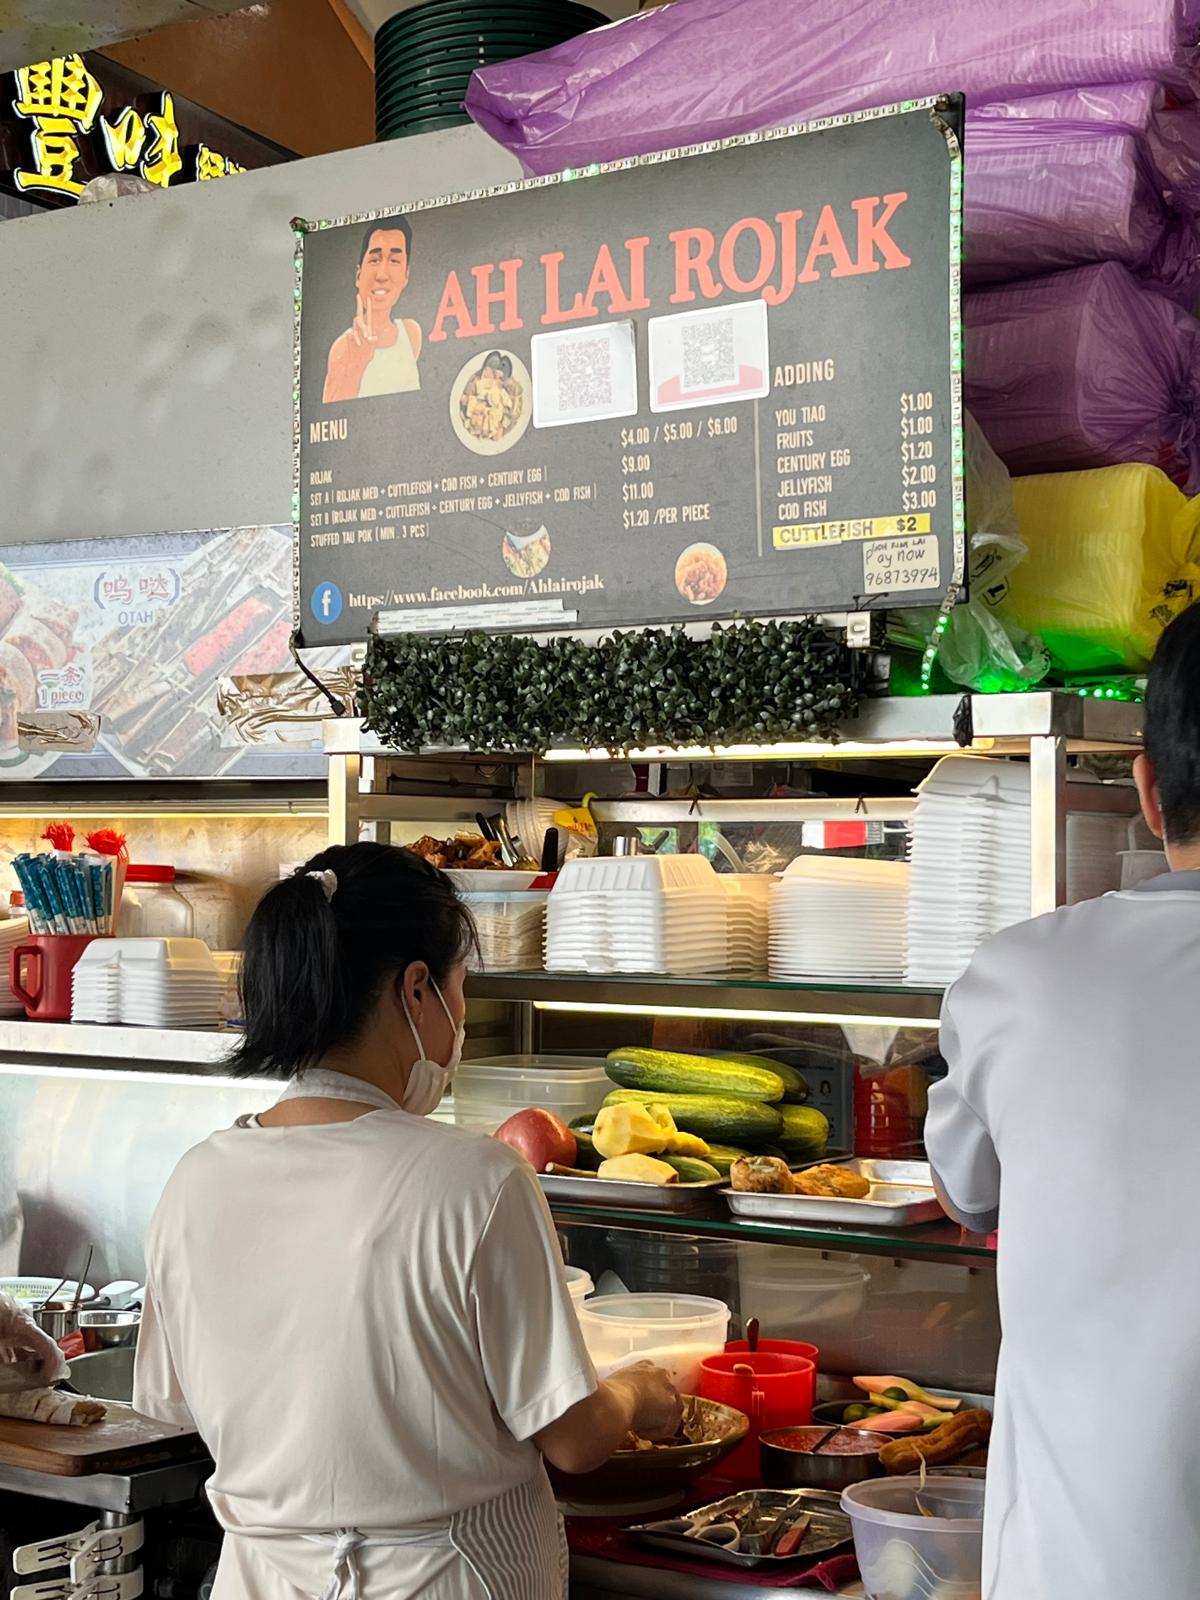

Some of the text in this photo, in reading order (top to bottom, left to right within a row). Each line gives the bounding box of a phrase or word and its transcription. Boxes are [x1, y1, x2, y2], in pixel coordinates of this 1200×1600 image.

[14, 53, 248, 200] 豐味
[428, 191, 912, 342] AH LAI ROJAK
[774, 358, 835, 387] ADDING
[900, 391, 933, 415] $1.00
[775, 404, 826, 427] YOU TIAO
[309, 418, 348, 444] MENU
[620, 426, 650, 449] $4.00
[663, 421, 693, 443] $5.00
[707, 415, 738, 438] $6.00
[900, 416, 933, 439] $1.00
[776, 430, 814, 450] FRUITS
[777, 448, 850, 474] CENTURY EGG
[901, 441, 933, 463] $1.20
[621, 454, 651, 475] $9.00
[901, 464, 937, 488] $2.00
[309, 469, 333, 485] ROJAK
[310, 492, 322, 506] SET
[362, 486, 379, 500] MED
[387, 480, 432, 498] CUTTLEFISH
[441, 477, 457, 492] COD
[460, 475, 478, 490] FISH
[488, 470, 524, 488] CENTURY
[777, 475, 833, 497] JELLYFISH
[622, 481, 654, 503] $11.00
[902, 489, 937, 512] $3.00
[310, 513, 322, 527] SET
[360, 507, 377, 521] MED
[385, 502, 431, 519] CUTTLEFISH
[439, 497, 475, 514] CENTURY
[478, 496, 493, 511] EGG
[502, 491, 544, 508] JELLYFISH
[554, 487, 570, 503] COD
[623, 509, 650, 530] $1.20
[682, 503, 710, 522] PIECE
[778, 499, 828, 520] COD FISH
[310, 532, 340, 548] STUFFED
[342, 531, 355, 545] TAU
[358, 528, 373, 543] POK
[402, 525, 407, 538] 3
[780, 516, 917, 543] CUTTLEFISH $2
[118, 610, 153, 625] OTAH
[51, 688, 84, 706] piece
